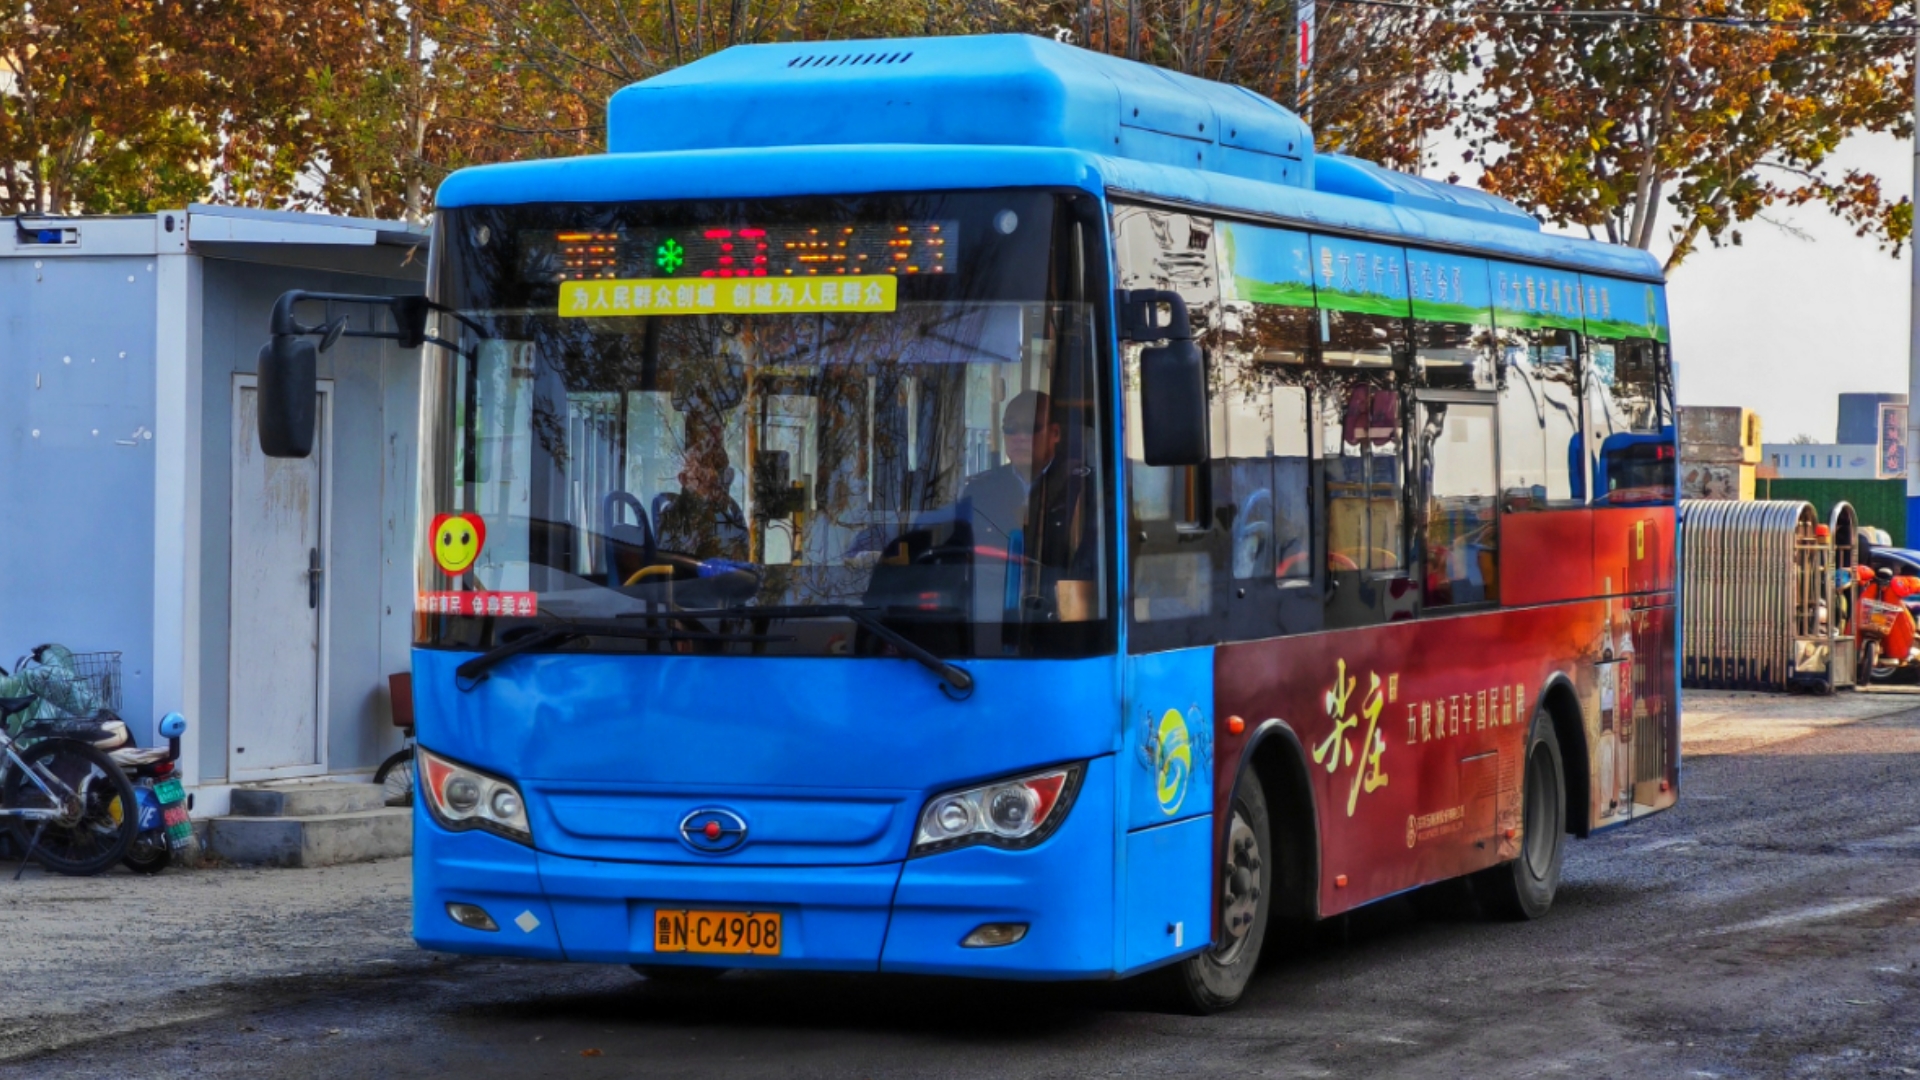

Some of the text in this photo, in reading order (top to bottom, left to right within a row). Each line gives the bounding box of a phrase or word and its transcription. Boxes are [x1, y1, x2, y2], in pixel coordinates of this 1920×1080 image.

[572, 281, 883, 310] 为人民群众创城 创城为人民群众
[1312, 657, 1389, 818] 尖庄
[1406, 682, 1525, 746] 五粮液百年国民品牌
[658, 916, 778, 949] 鲁N·C4908
